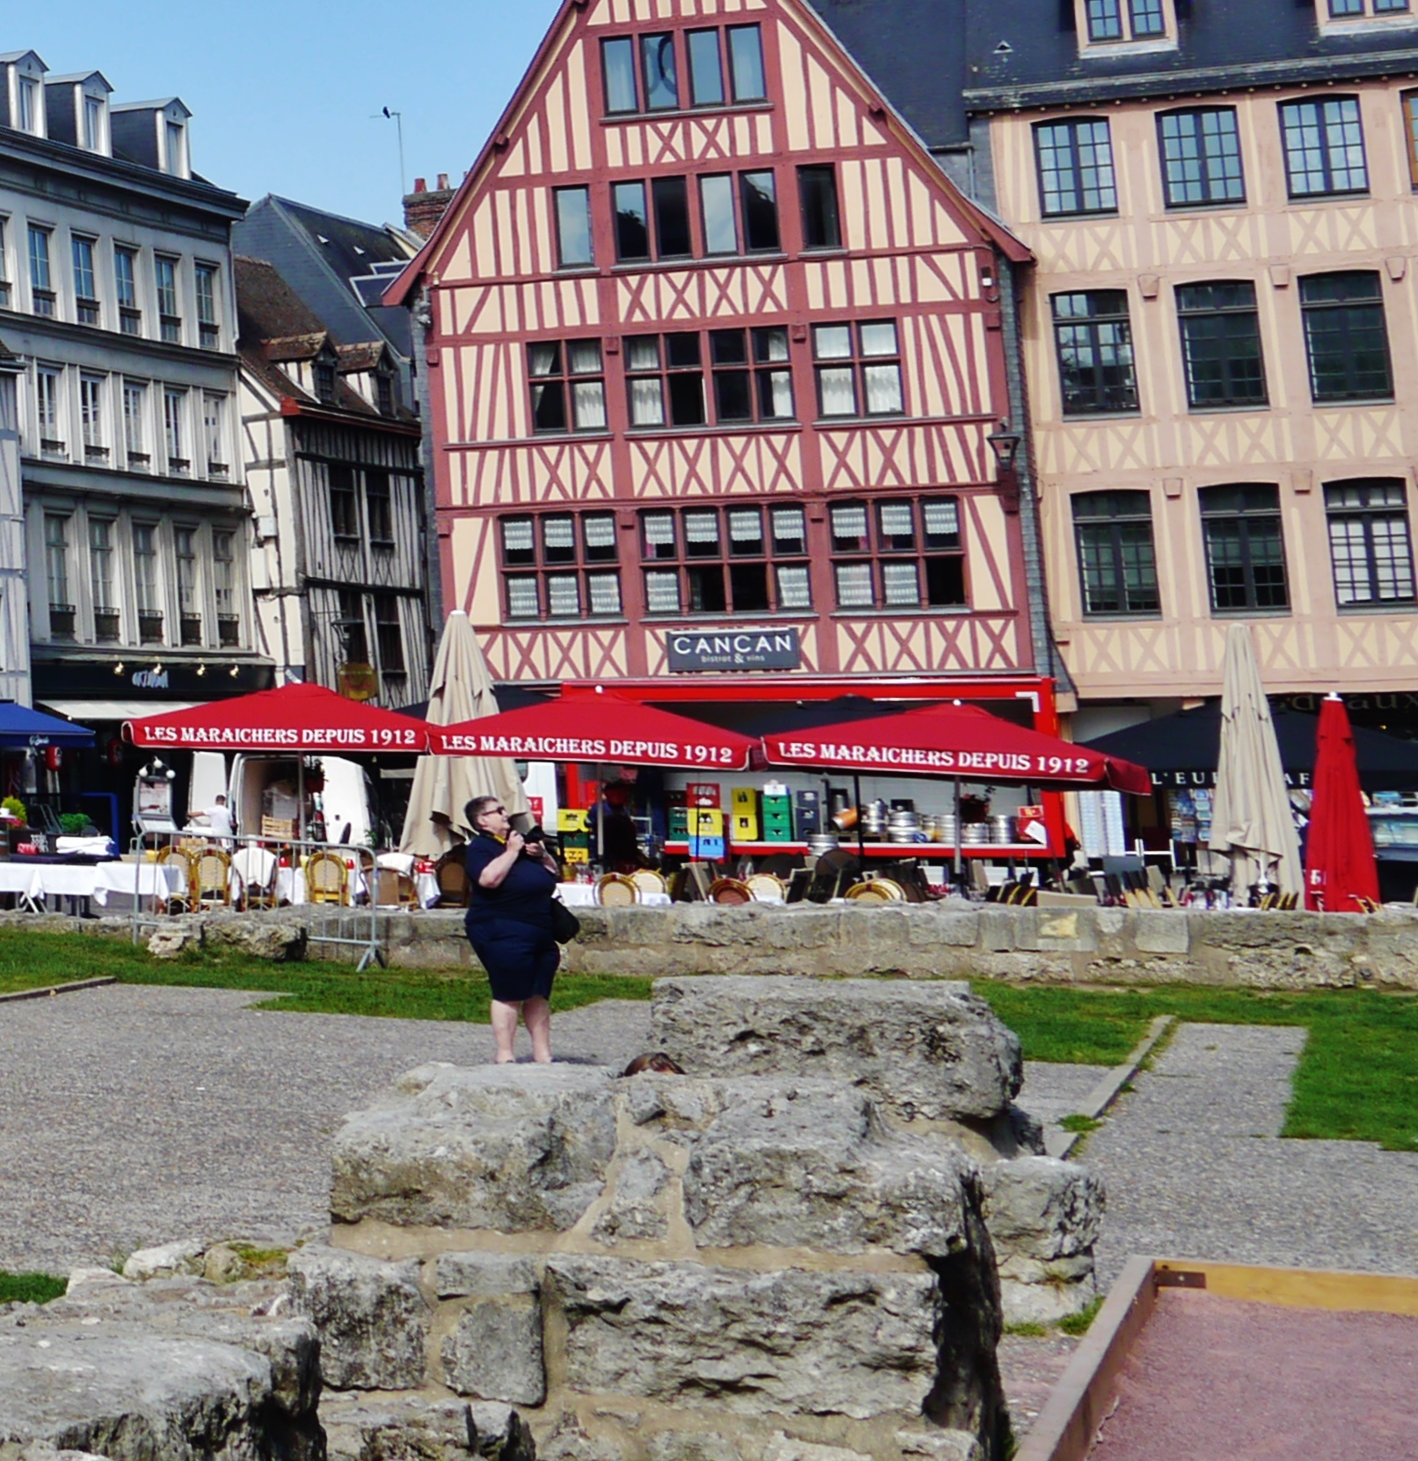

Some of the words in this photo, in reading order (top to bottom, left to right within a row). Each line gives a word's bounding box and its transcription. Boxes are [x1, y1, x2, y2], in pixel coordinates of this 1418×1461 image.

[673, 635, 791, 654] CANCAN
[734, 653, 744, 664] &
[144, 726, 177, 741] LES
[180, 727, 298, 743] MARAICHERS
[301, 728, 365, 743] DEPUIS
[371, 729, 415, 744] 1912
[441, 734, 475, 750] LES
[480, 736, 606, 755] MARAICHERS
[610, 740, 678, 759] DEPUIS
[684, 745, 733, 763] 1912
[778, 741, 816, 758] LES
[820, 743, 954, 766] MARAICHERS
[958, 749, 1031, 770] DEPUIS
[1037, 756, 1089, 774] 1912
[1151, 772, 1217, 785] L'EU
[1283, 772, 1311, 785] AF
